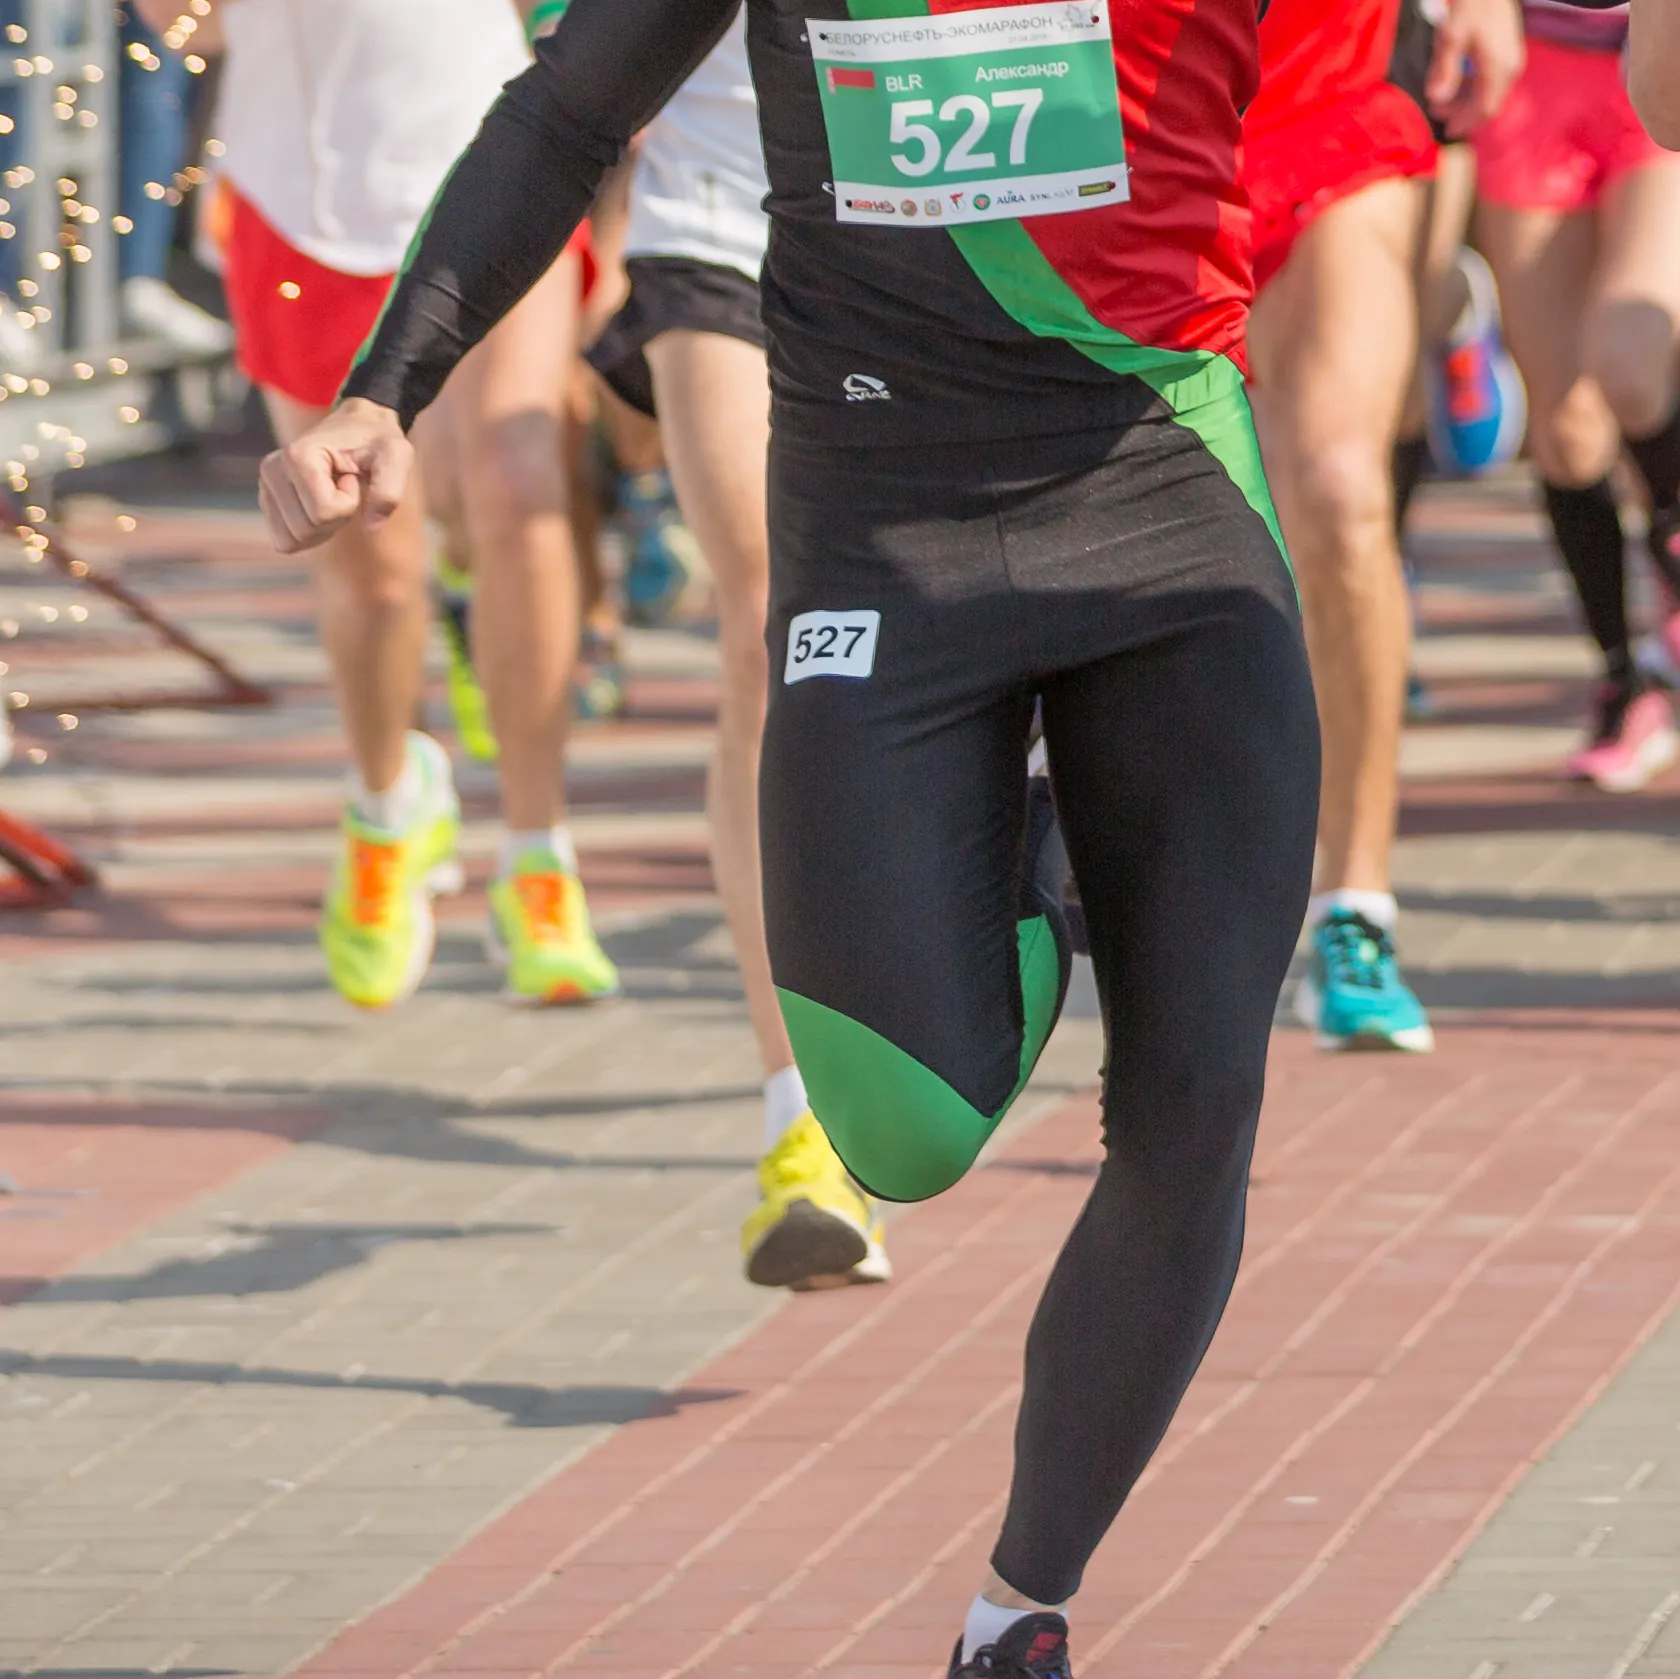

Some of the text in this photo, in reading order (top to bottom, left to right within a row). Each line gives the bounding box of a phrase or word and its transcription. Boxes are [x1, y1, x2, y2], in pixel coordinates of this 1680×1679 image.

[885, 73, 924, 92] BLR
[975, 60, 1070, 83] Александр
[889, 88, 1044, 177] 527
[996, 194, 1026, 205] AURA
[793, 625, 867, 664] 527
